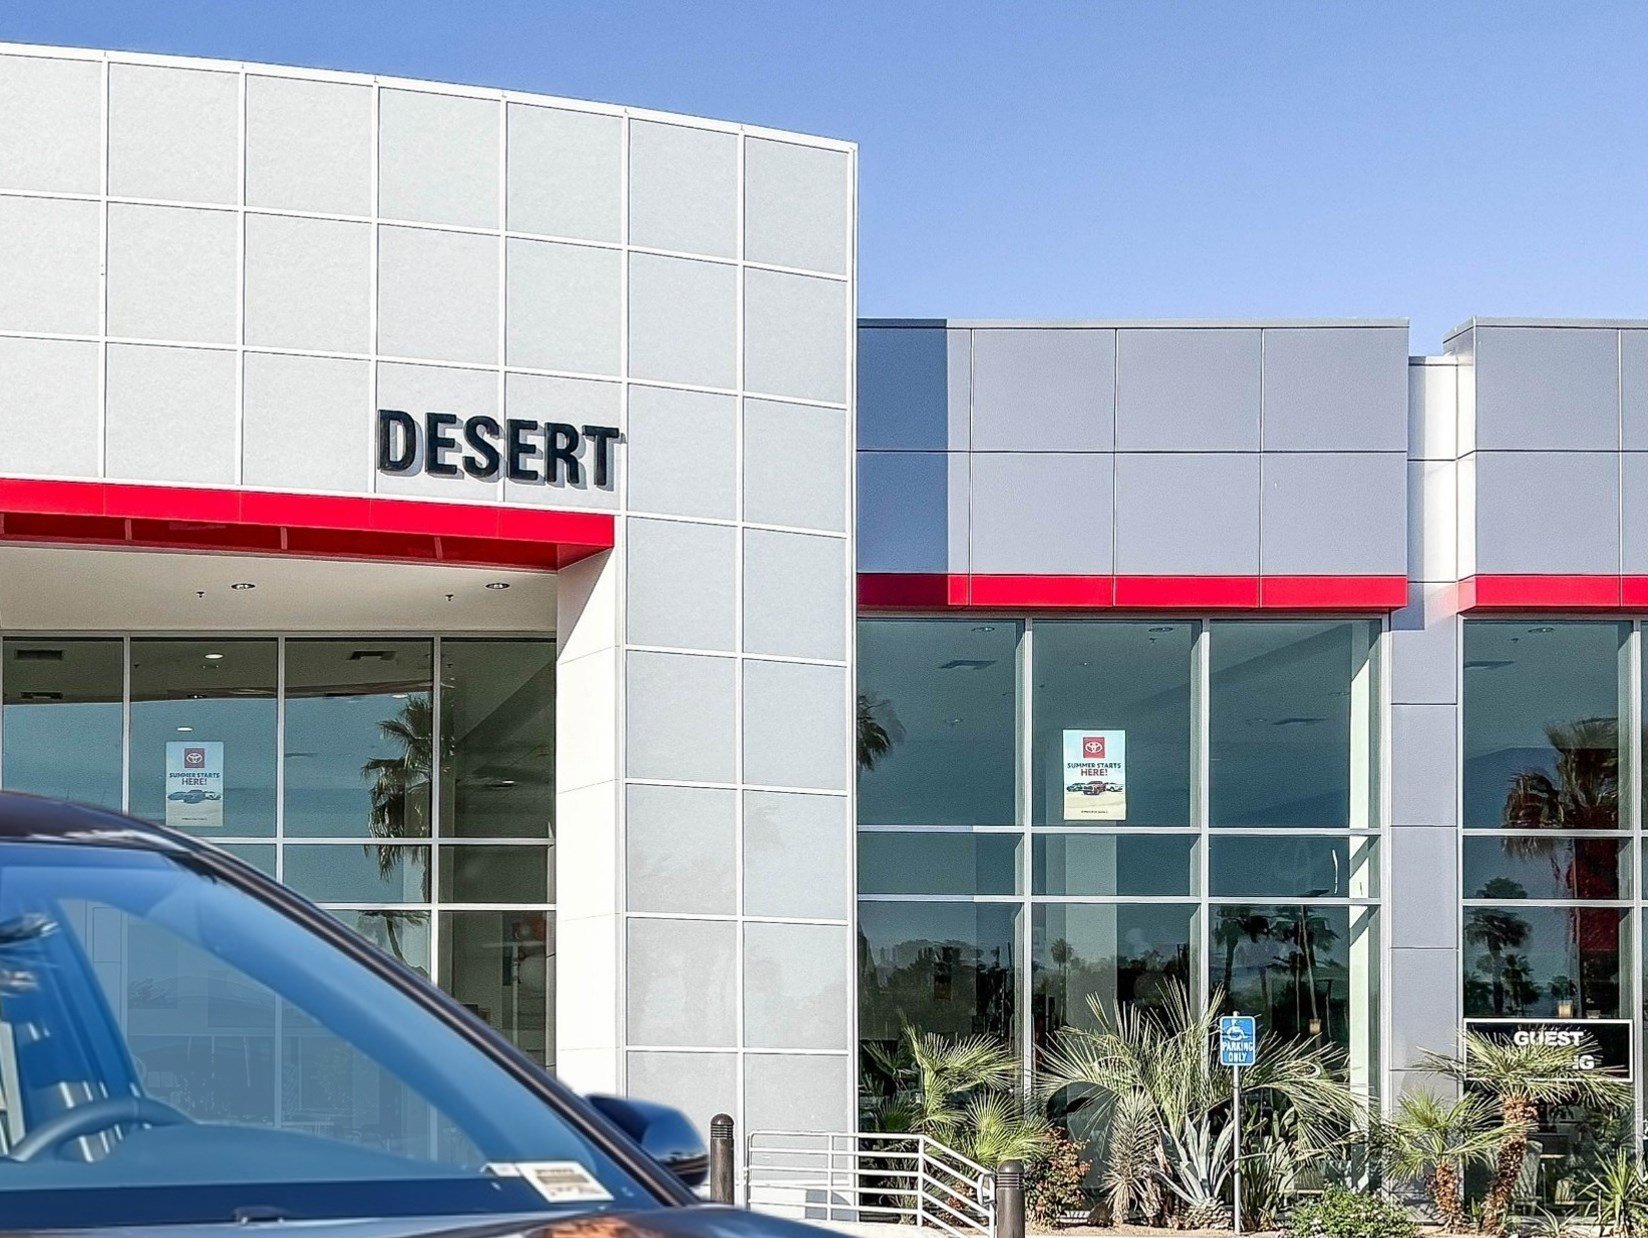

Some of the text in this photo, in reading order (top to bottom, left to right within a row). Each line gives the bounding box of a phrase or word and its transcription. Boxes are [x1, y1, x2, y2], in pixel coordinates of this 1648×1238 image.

[376, 409, 620, 487] DESERT
[181, 778, 207, 786] HERE!
[1513, 1030, 1584, 1047] GUEST
[1222, 1042, 1254, 1052] PARKING
[1228, 1052, 1247, 1062] ONLY
